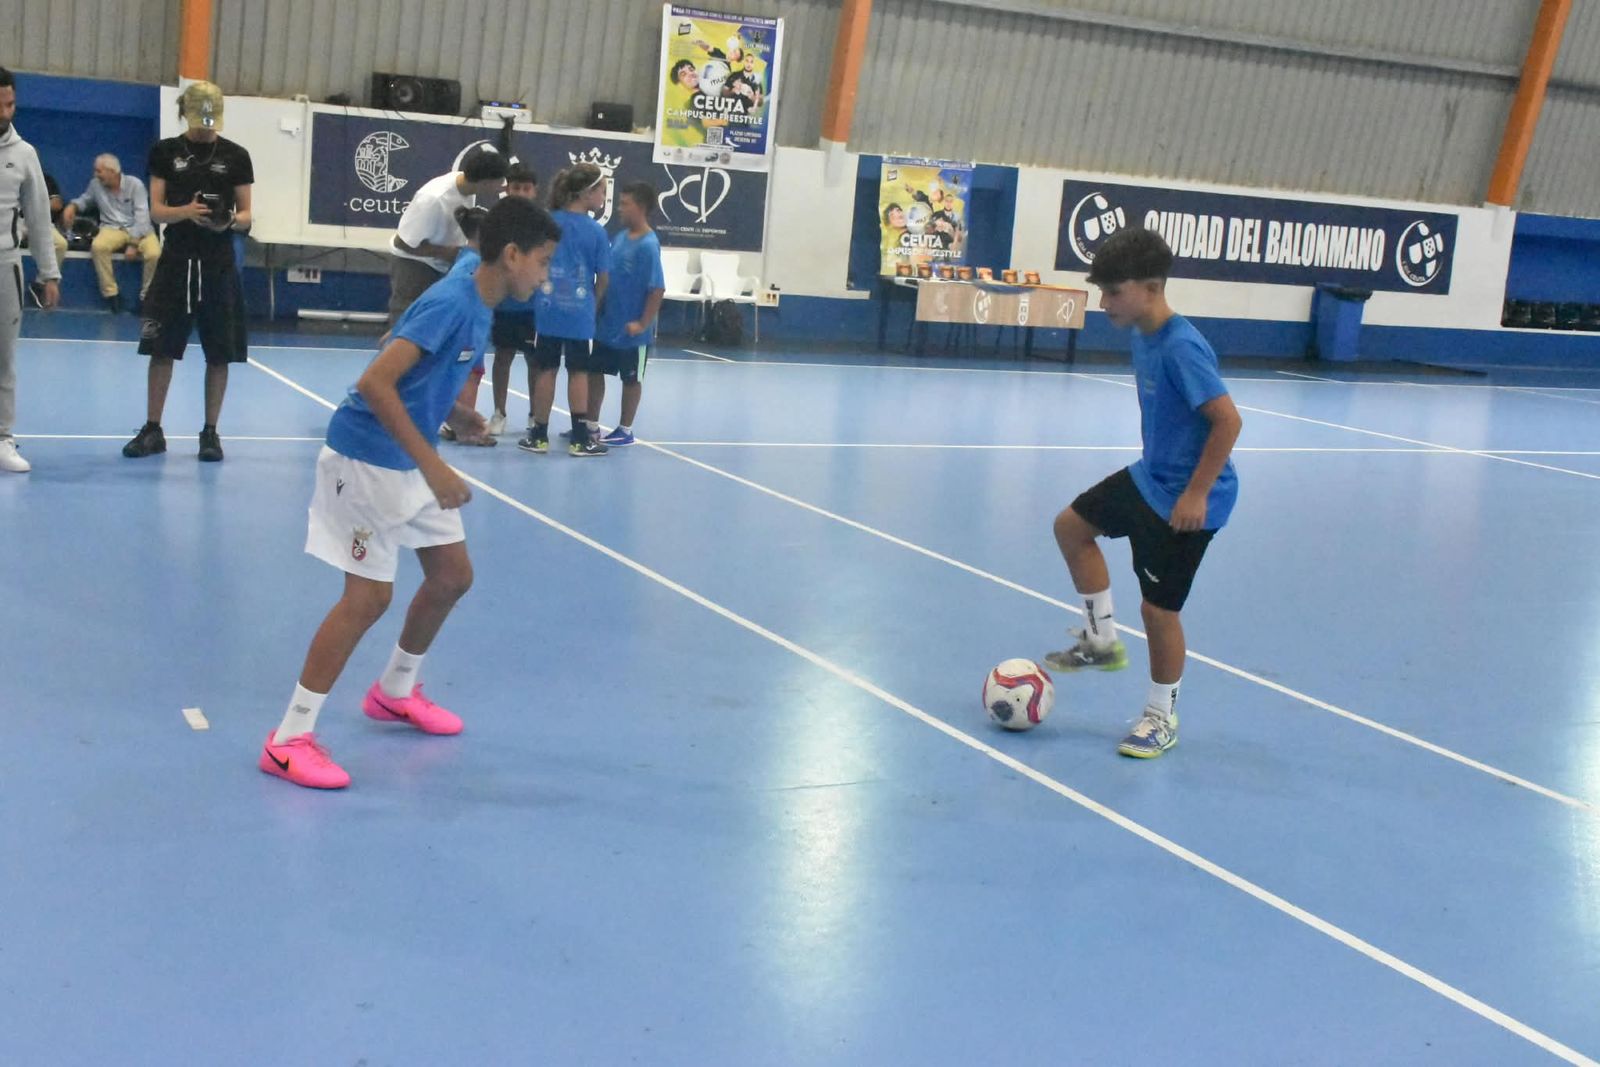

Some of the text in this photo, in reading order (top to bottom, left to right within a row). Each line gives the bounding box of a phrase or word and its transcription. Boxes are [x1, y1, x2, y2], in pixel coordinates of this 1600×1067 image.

[693, 94, 745, 113] CEUTA
[666, 107, 763, 125] CAMPUS DE FREESTYLE
[900, 233, 943, 249] CEUTA
[1226, 217, 1262, 264] DEL
[1264, 220, 1386, 272] BALONMANO
